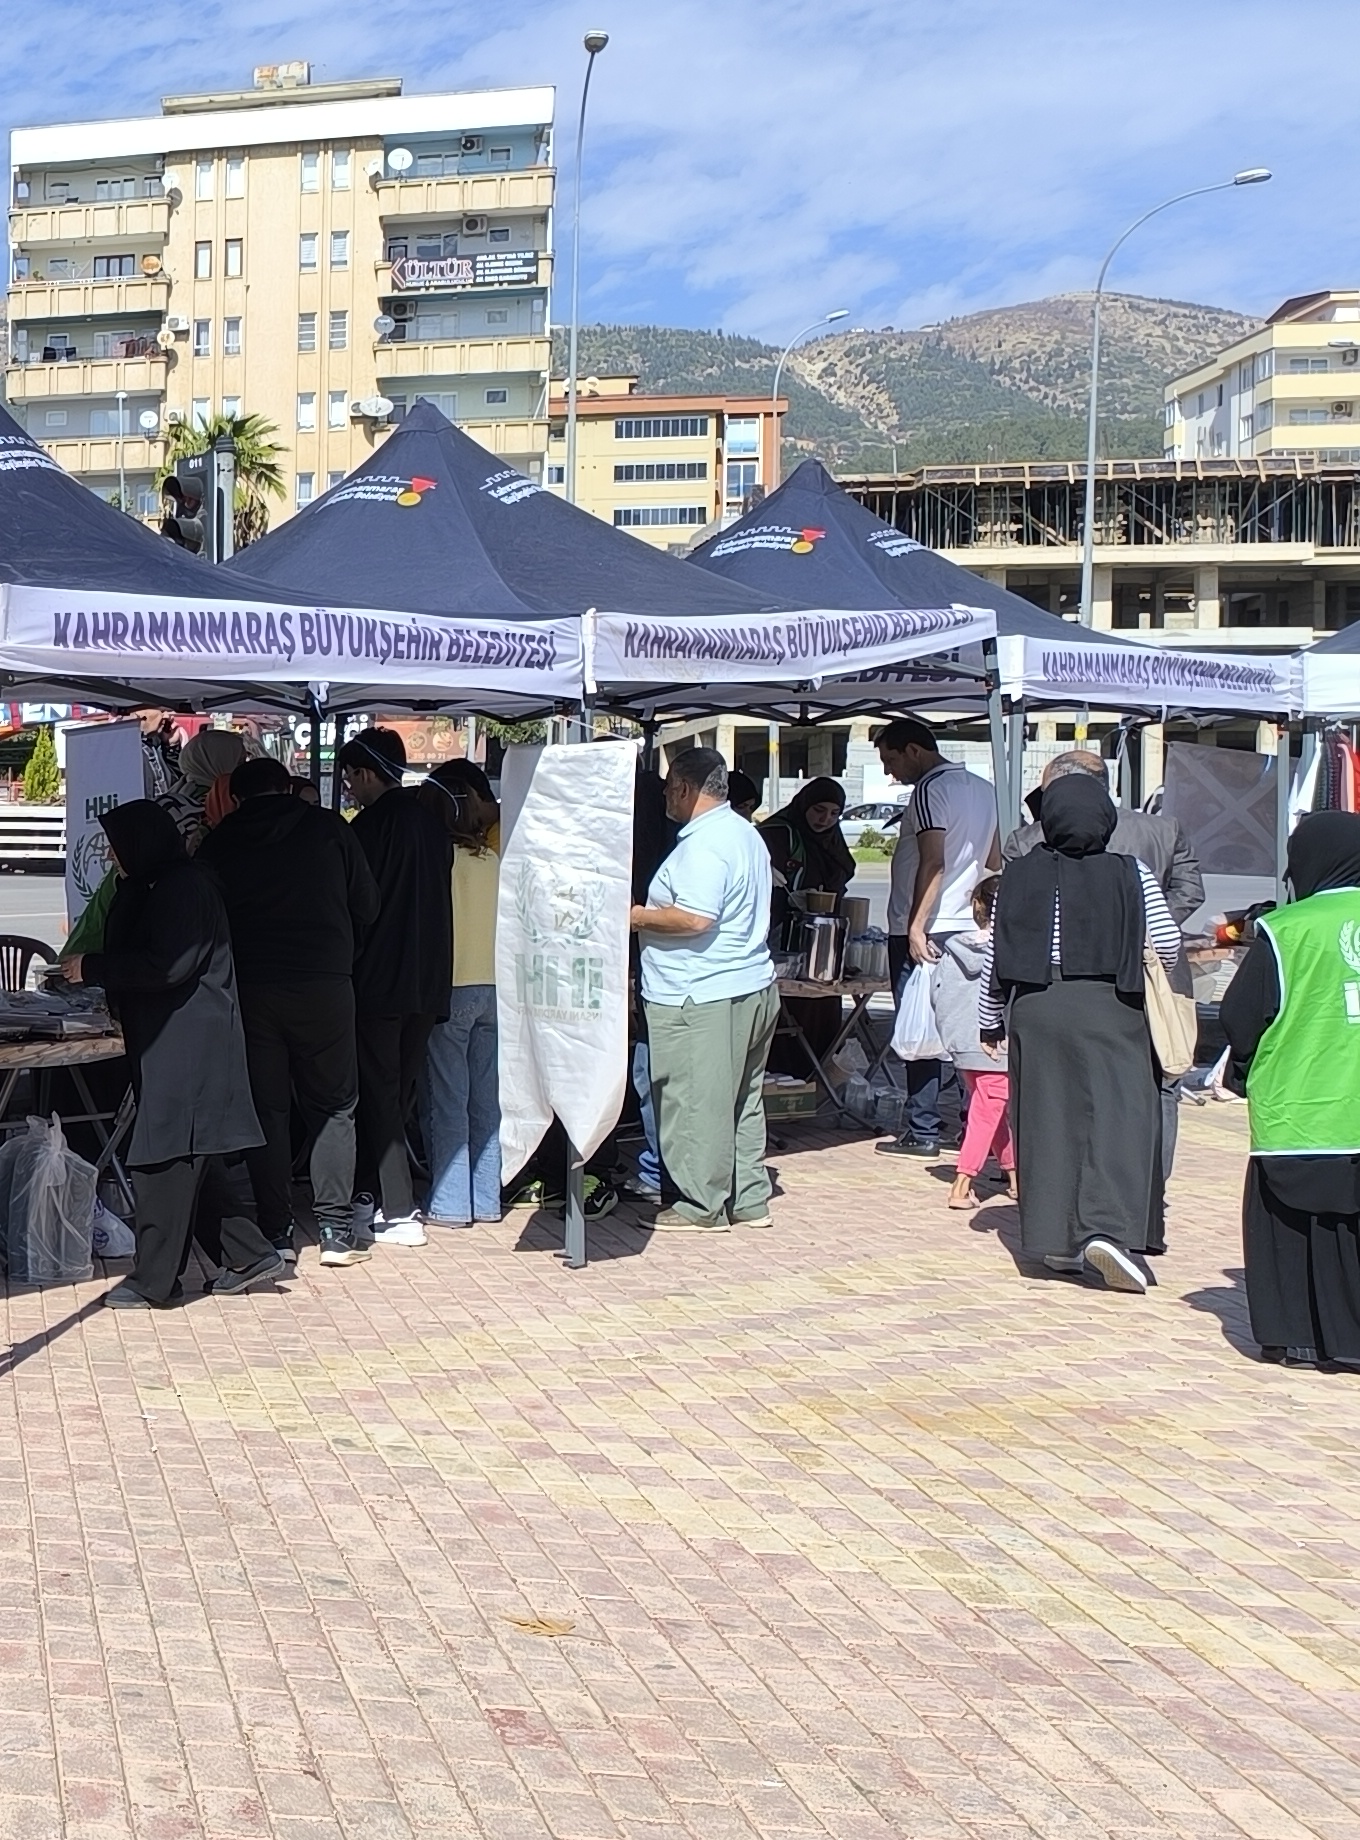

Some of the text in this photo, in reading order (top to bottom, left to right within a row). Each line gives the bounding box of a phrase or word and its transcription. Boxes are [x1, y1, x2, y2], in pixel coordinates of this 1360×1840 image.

[189, 457, 203, 469] 011
[53, 608, 557, 672] KAHRAMANMARAŞ BÜYÜKŞEHİR BELEDİYESİ
[623, 621, 786, 666] KAHRAMANMARAŞ
[787, 610, 889, 658] BÜYÜKŞEHİR
[1042, 652, 1151, 690] KAHRAMANMARAŞ
[1151, 652, 1219, 692] BÜYÜKŞEHİR
